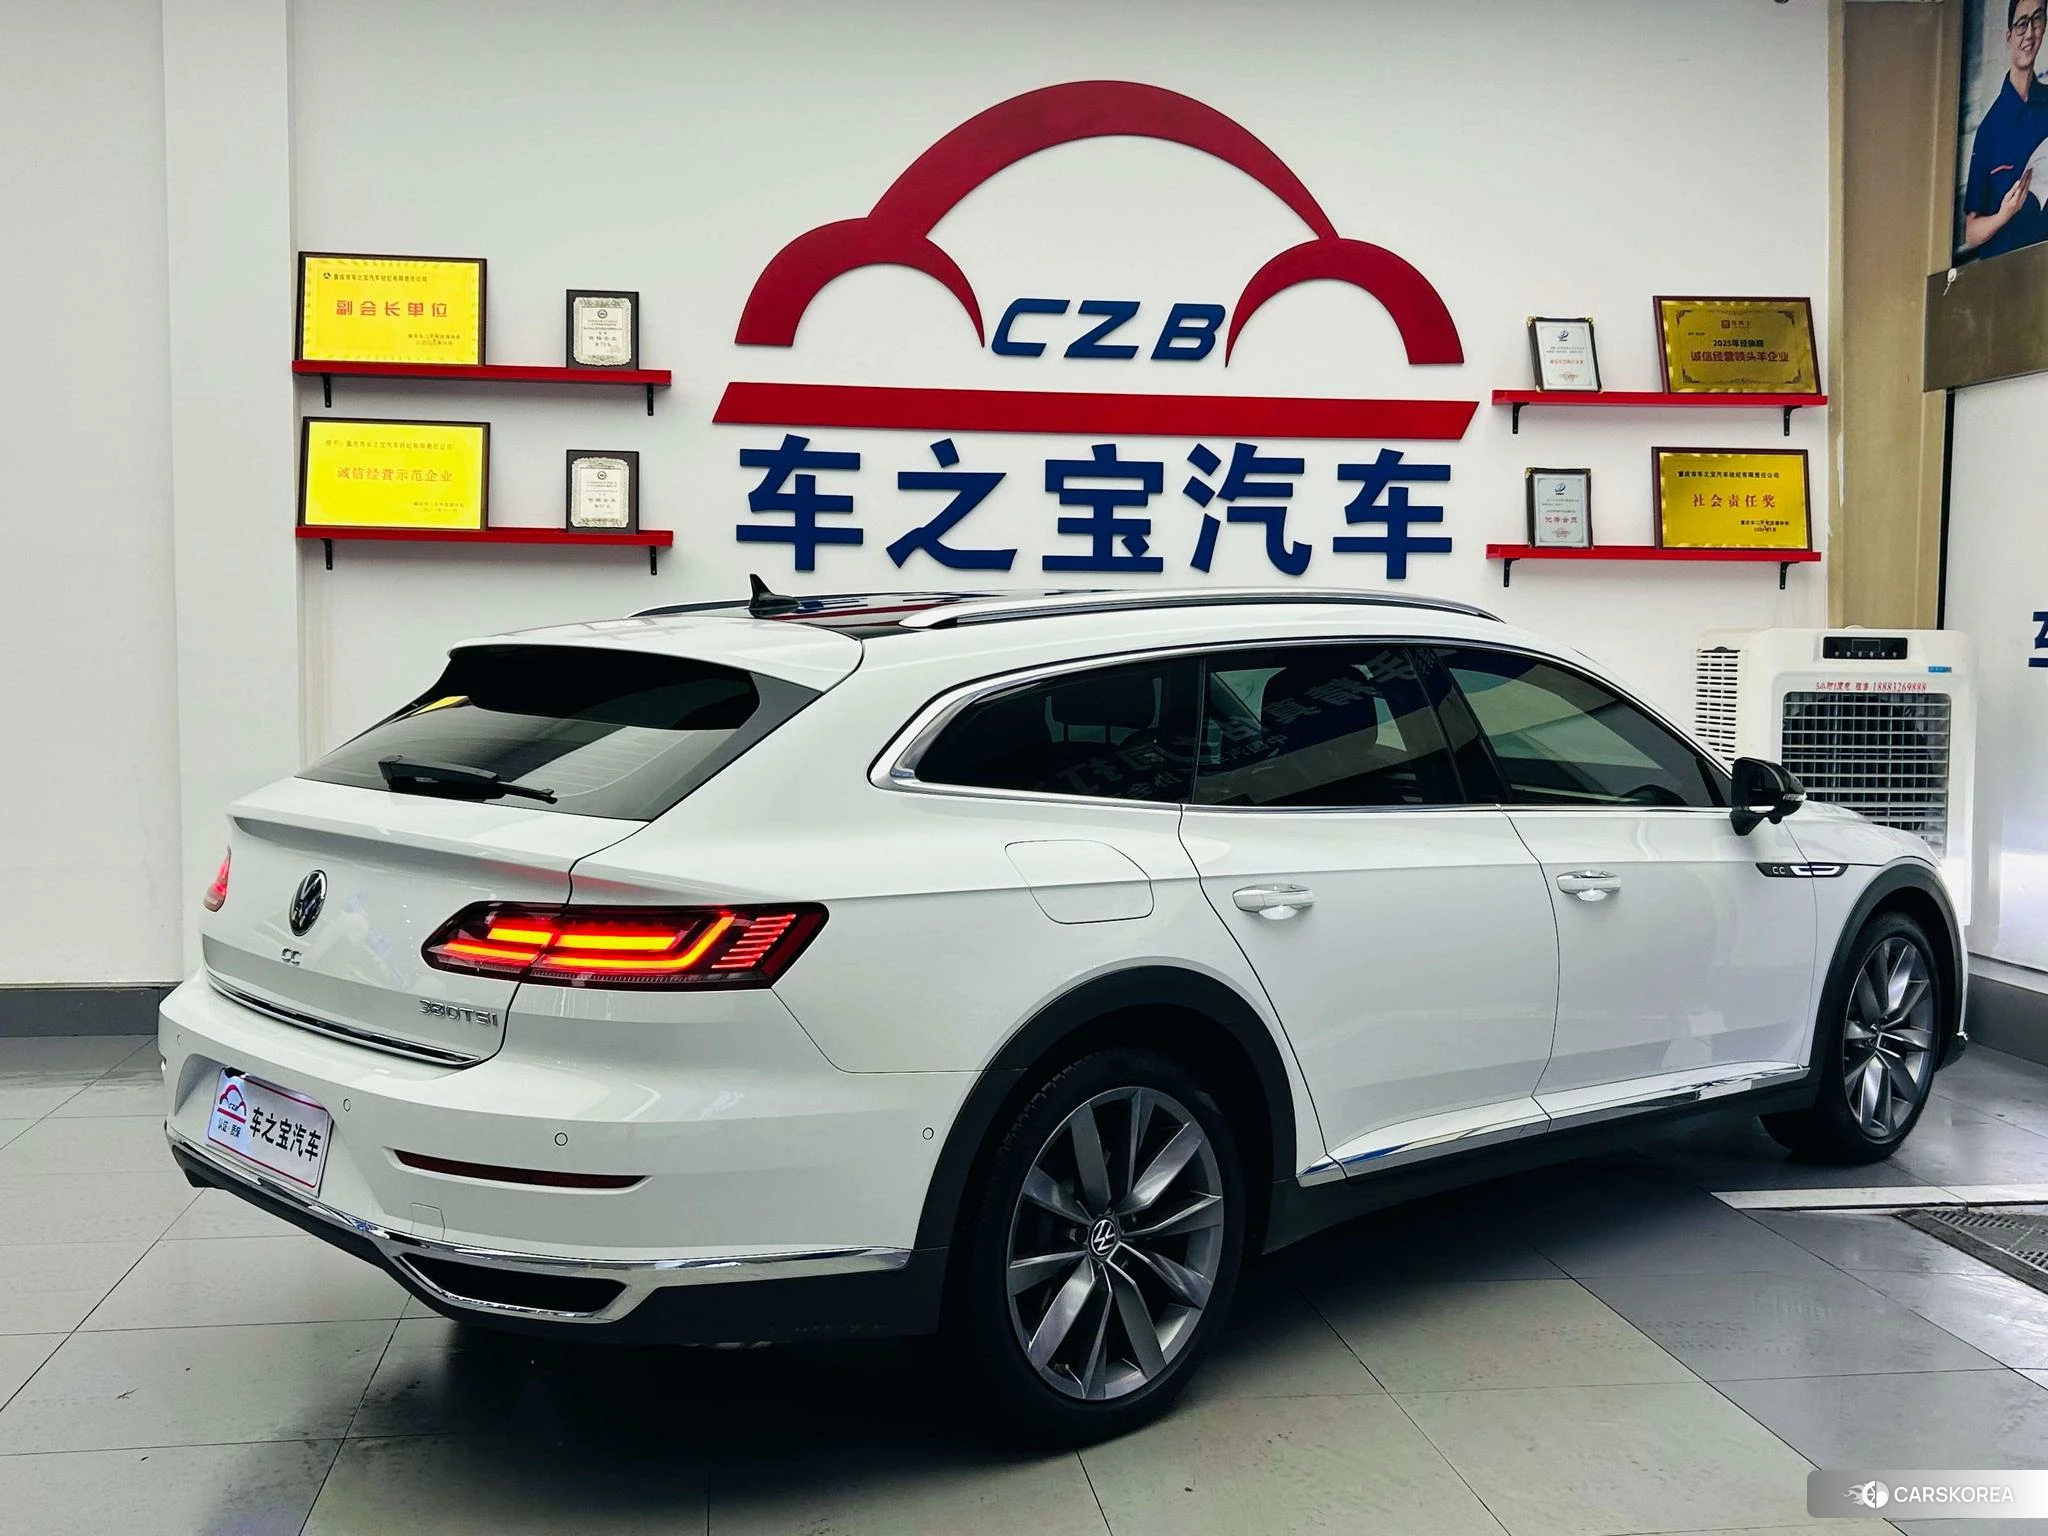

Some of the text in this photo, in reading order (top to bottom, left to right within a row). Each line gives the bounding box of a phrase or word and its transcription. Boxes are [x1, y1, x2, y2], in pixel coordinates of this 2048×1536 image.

[336, 300, 447, 317] 副会长单位
[991, 297, 1226, 361] CZB
[1691, 351, 1789, 362] 诚信经营领头羊企业
[337, 467, 453, 482] 诚信经营示范企业
[735, 434, 1453, 579] 车之宝汽车
[1692, 494, 1776, 508] 社会责任奖
[1772, 866, 1786, 875] CC
[281, 948, 302, 966] CC
[419, 999, 498, 1028] 380TSI
[249, 1107, 322, 1162] 车之宝汽车
